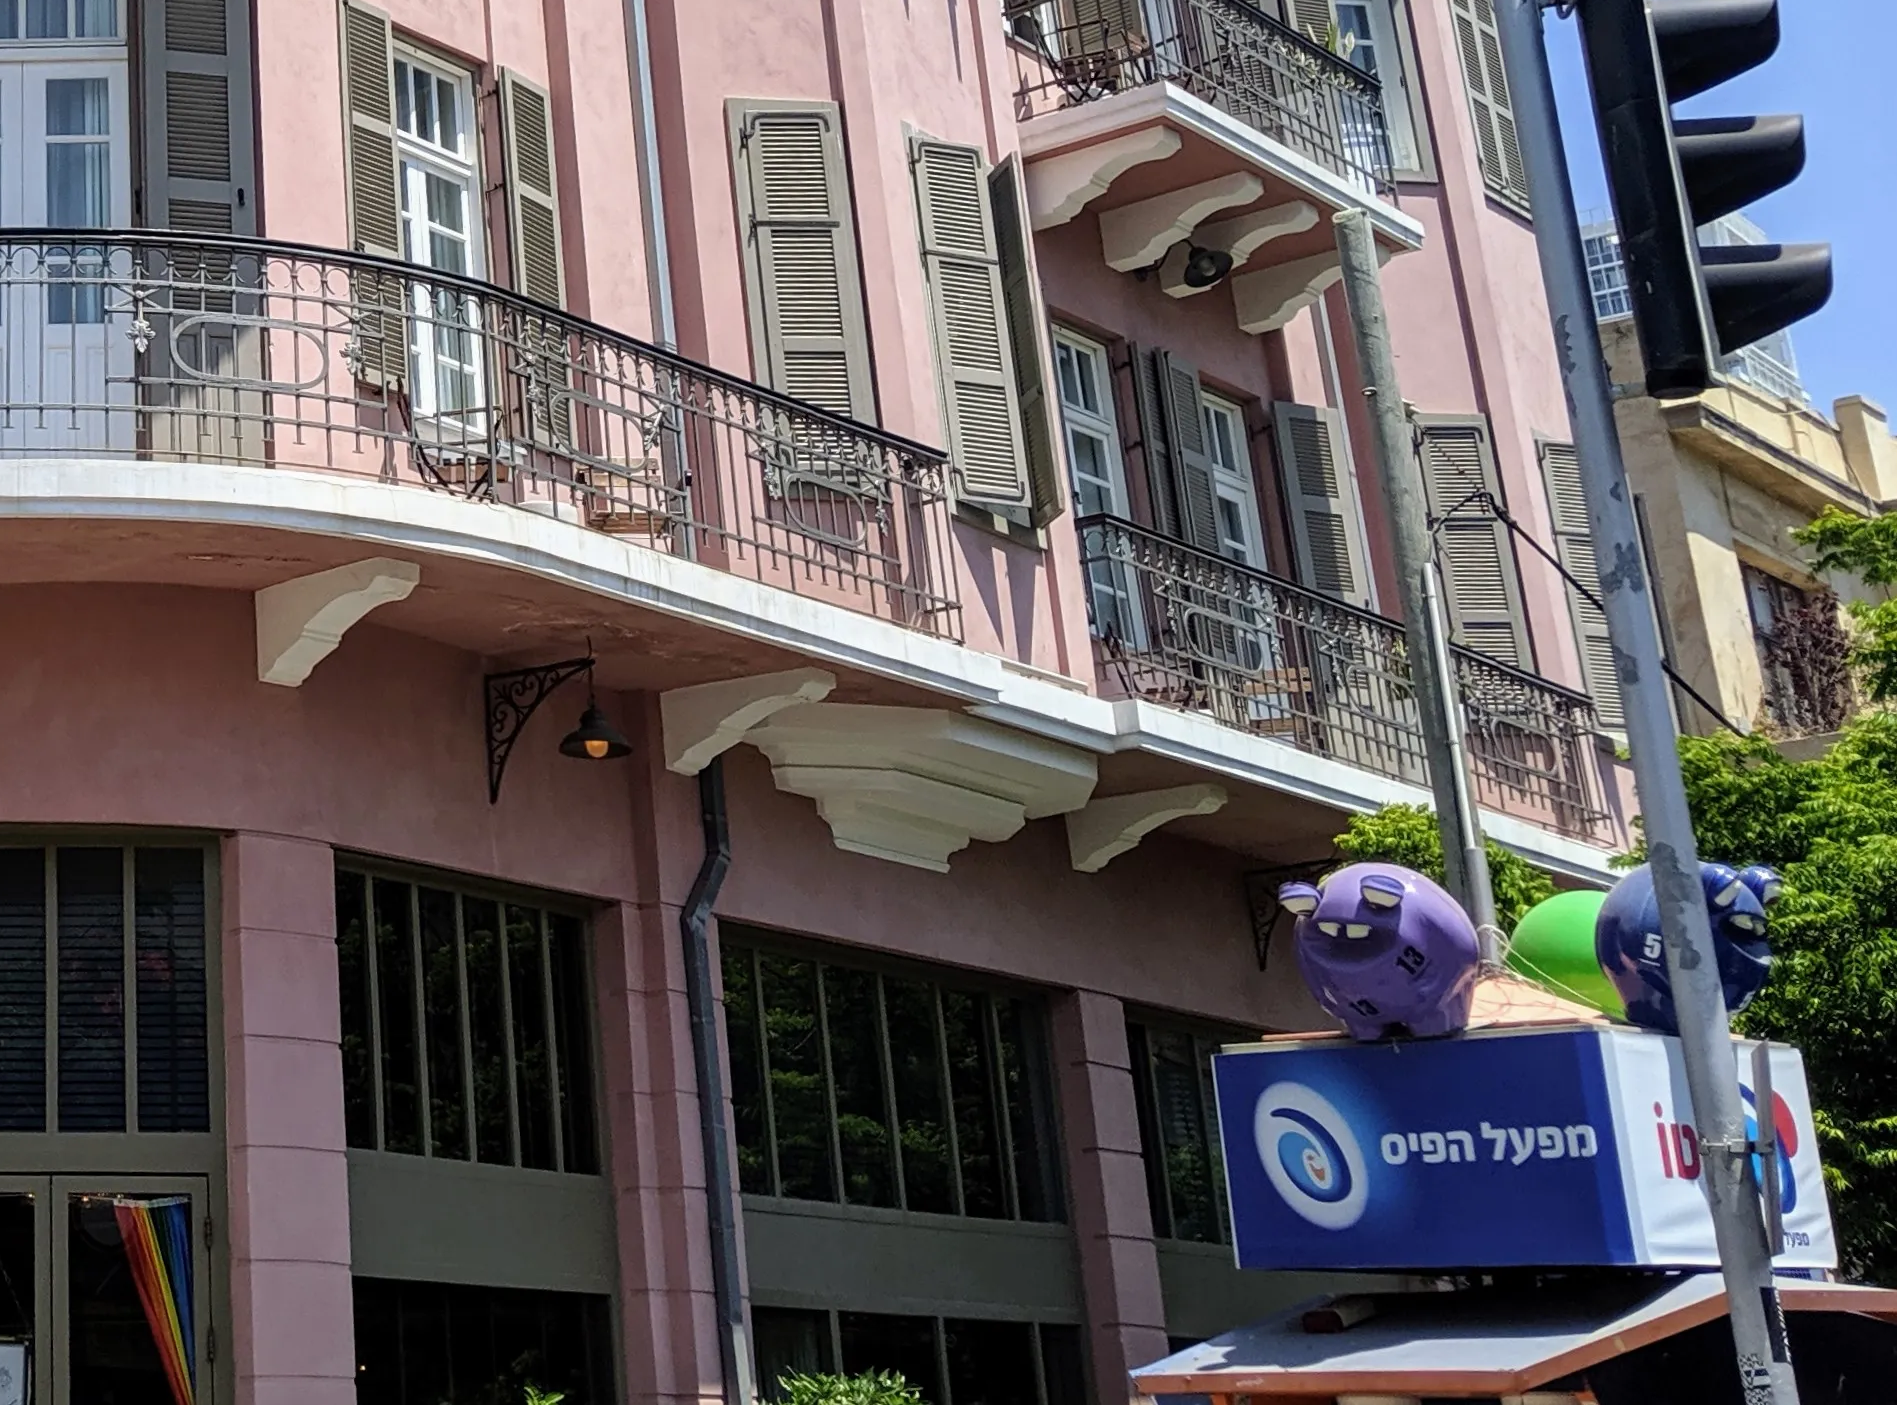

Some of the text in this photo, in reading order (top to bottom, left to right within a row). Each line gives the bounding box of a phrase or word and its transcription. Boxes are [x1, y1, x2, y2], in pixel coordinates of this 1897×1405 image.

[1395, 945, 1425, 975] 13
[1644, 933, 1662, 959] 5
[1380, 1121, 1598, 1165] מפעל הפיס
